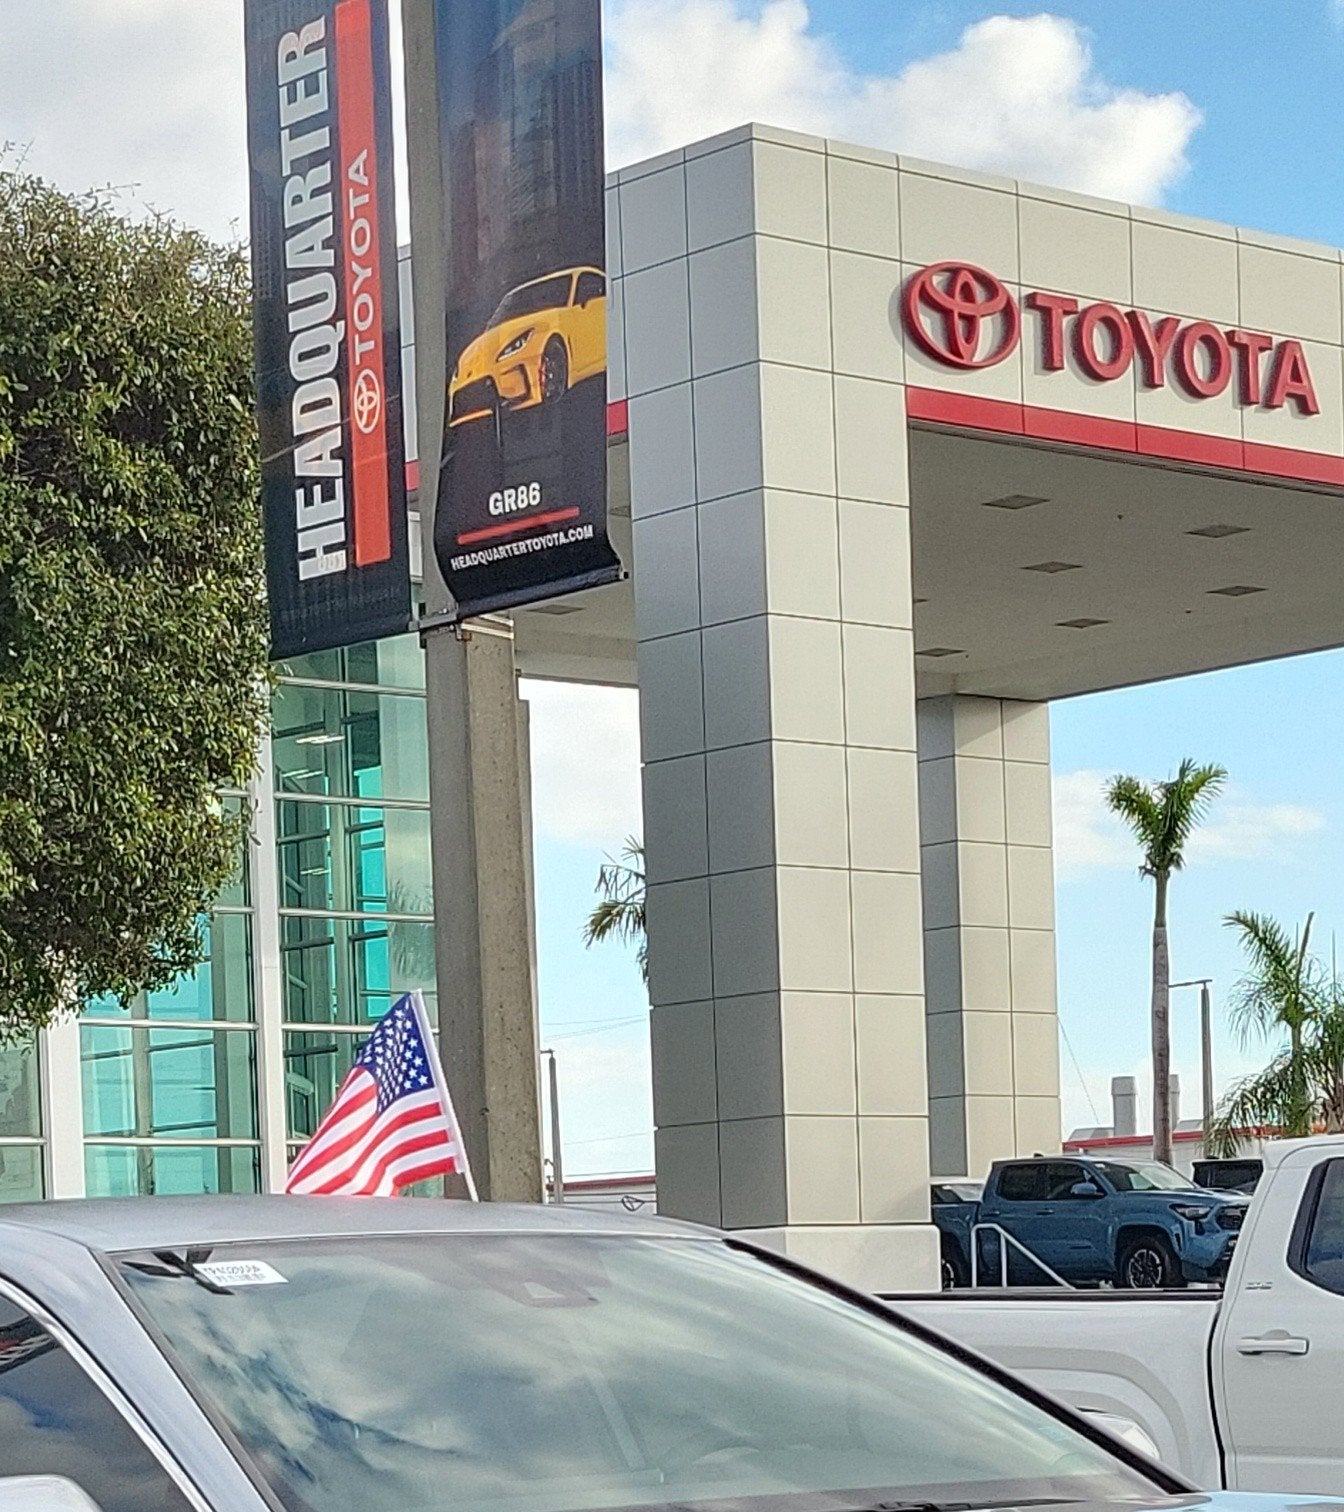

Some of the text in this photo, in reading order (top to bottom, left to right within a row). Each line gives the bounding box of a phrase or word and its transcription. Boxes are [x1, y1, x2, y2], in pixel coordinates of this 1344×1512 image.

[277, 14, 348, 582] HEADQUARTER
[347, 148, 377, 366] TOYOTA
[1026, 289, 1321, 416] TOYOTA
[450, 524, 594, 571] HEADQUARTERTOYOTA.COM
[488, 481, 541, 517] GR86
